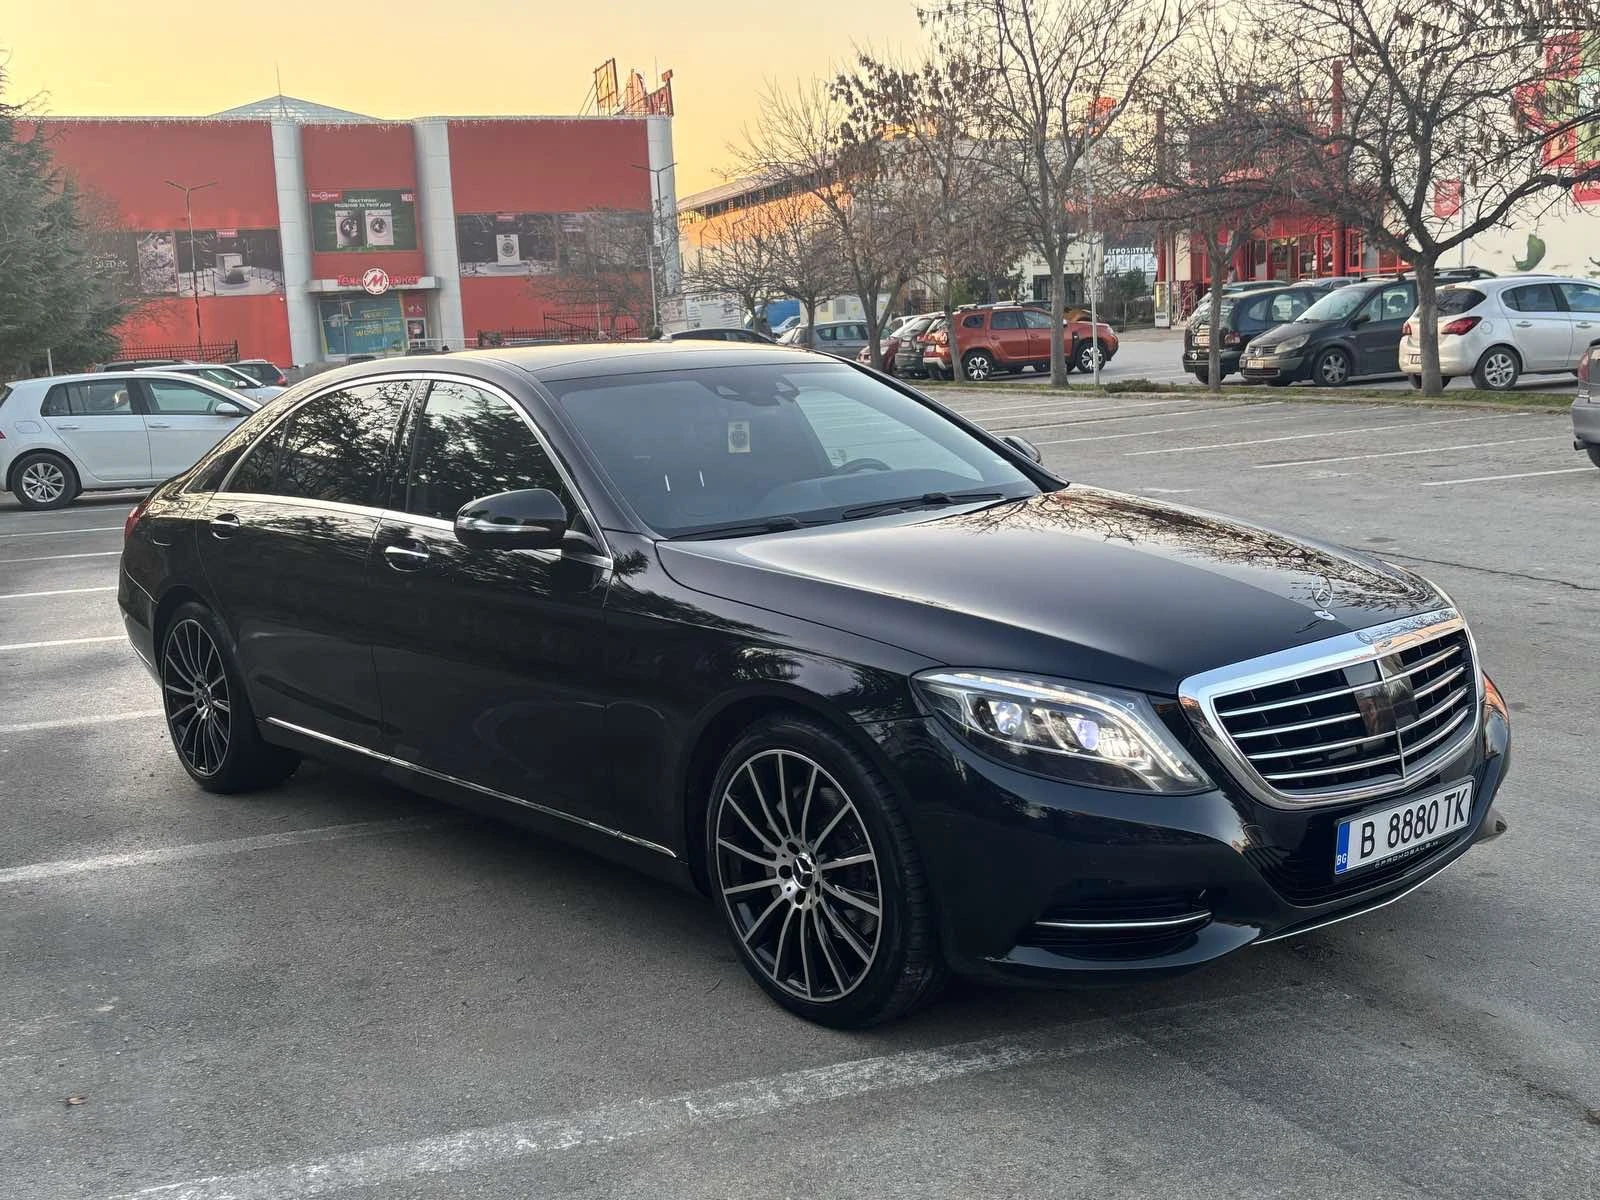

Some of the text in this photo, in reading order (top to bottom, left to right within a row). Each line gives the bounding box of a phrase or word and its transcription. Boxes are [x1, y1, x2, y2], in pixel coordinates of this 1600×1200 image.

[1360, 788, 1468, 859] B 8880 TK
[1336, 853, 1347, 866] BG
